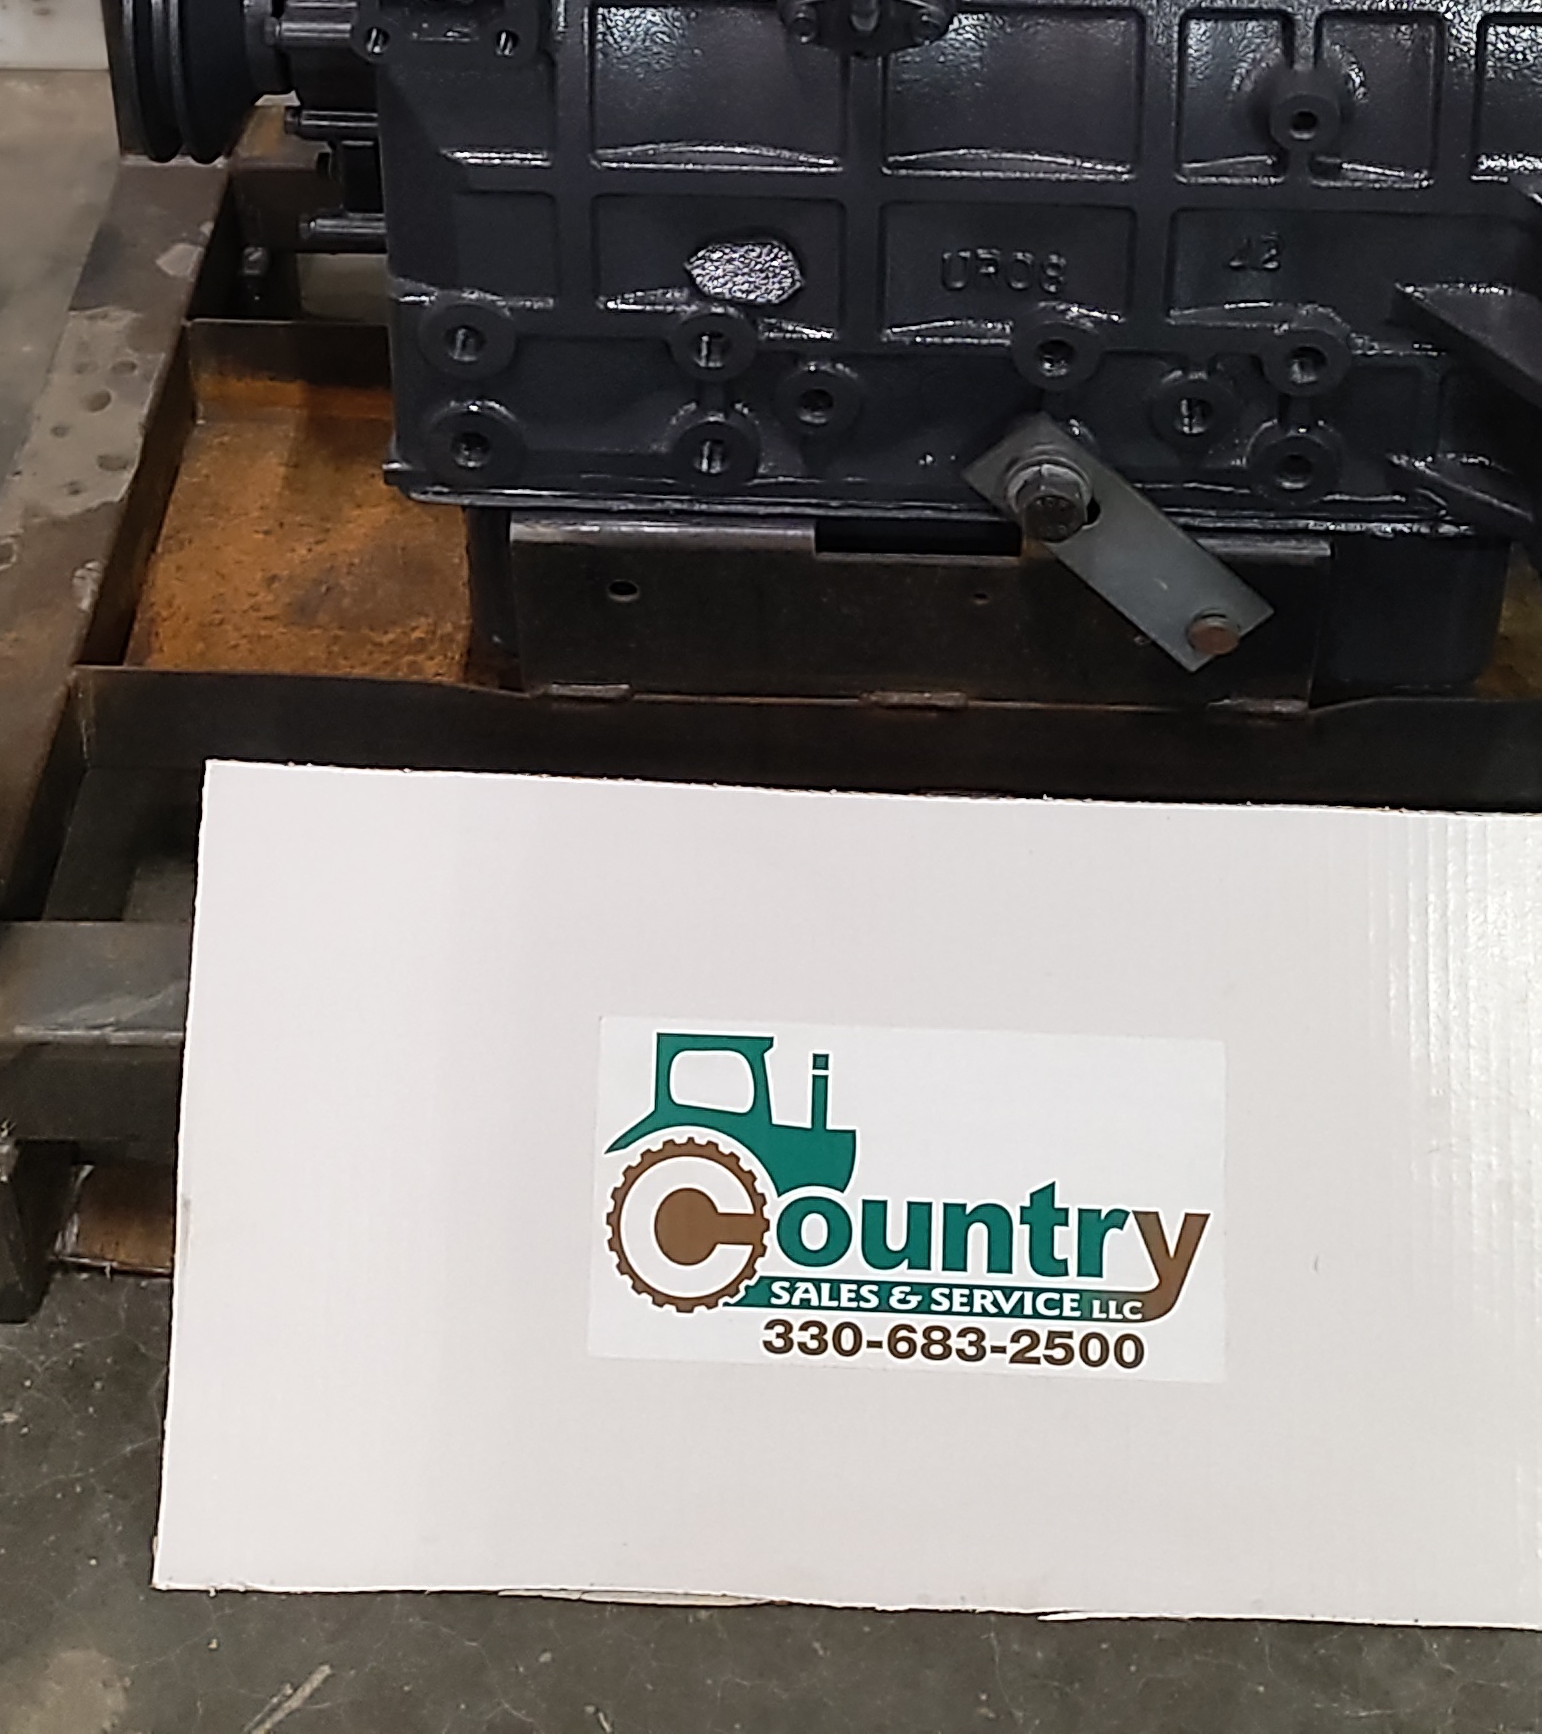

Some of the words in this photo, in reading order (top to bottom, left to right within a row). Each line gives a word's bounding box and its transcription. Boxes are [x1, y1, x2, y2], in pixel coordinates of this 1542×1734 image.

[606, 1137, 1211, 1321] Country
[769, 1280, 880, 1309] SALES
[888, 1284, 923, 1311] &
[929, 1287, 1083, 1319] SERVICE
[1091, 1297, 1144, 1321] LLC
[761, 1318, 1146, 1370] 330-683-2500
